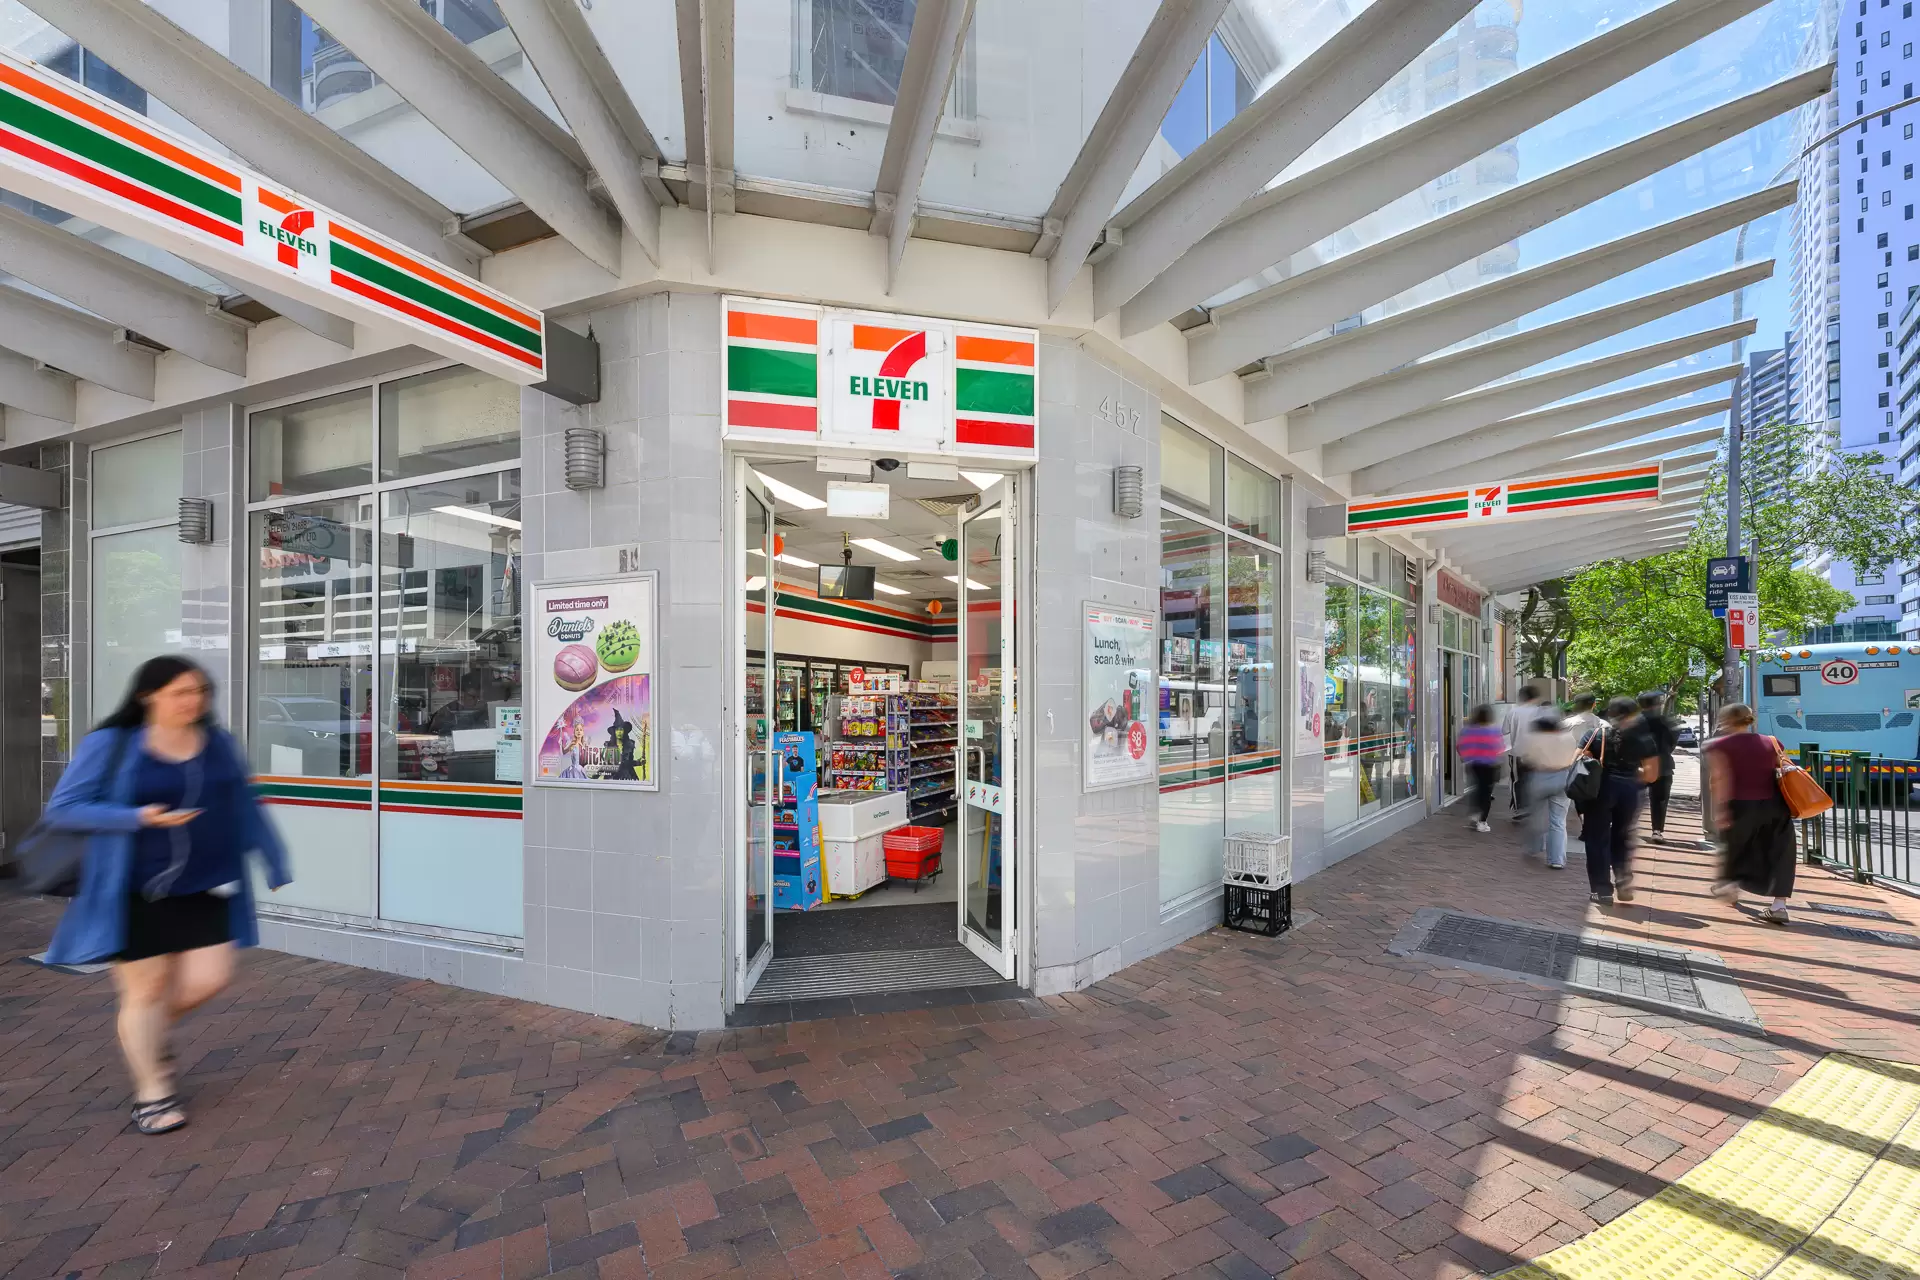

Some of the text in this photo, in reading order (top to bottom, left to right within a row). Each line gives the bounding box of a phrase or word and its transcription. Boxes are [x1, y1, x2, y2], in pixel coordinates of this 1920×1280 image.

[258, 188, 315, 270] 7
[853, 324, 926, 430] 7
[1098, 395, 1141, 436] 457
[1724, 580, 1738, 588] and
[548, 598, 606, 610] Limited time only
[1094, 636, 1120, 652] Lunch,
[1094, 655, 1113, 665] scan
[1114, 654, 1120, 666] &
[853, 673, 861, 681] $7
[1827, 667, 1853, 678] 40
[1131, 730, 1142, 747] $8
